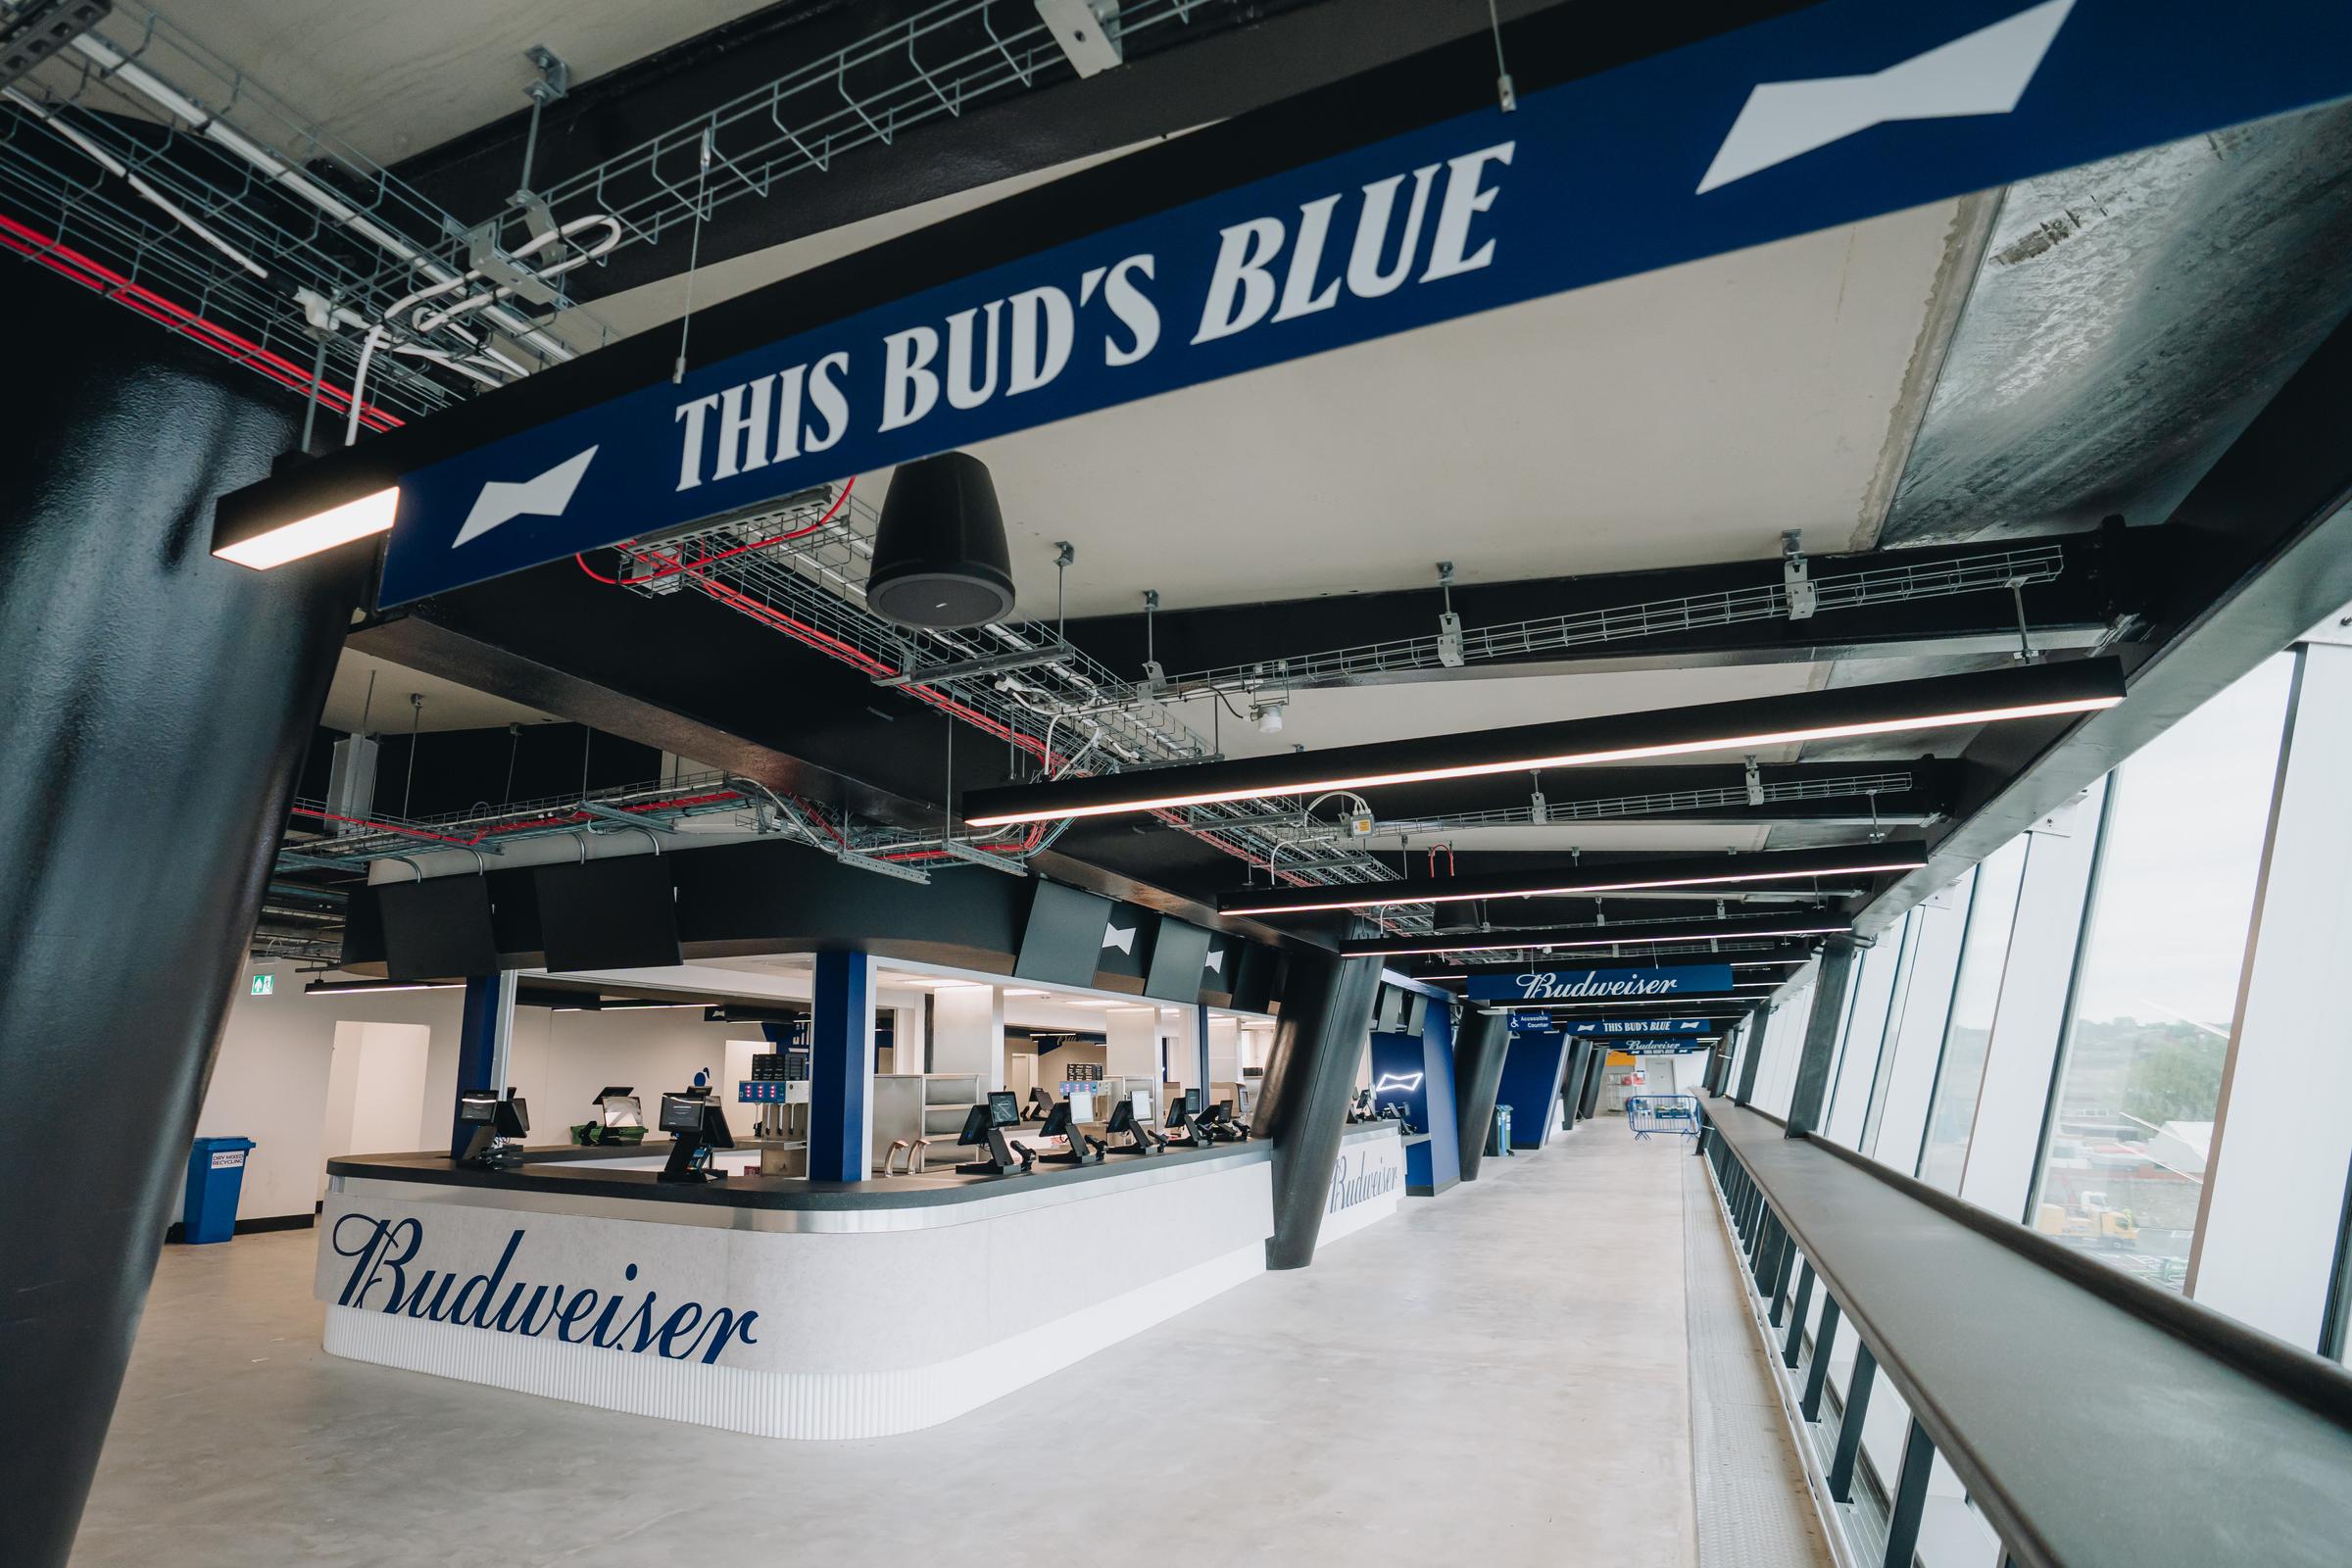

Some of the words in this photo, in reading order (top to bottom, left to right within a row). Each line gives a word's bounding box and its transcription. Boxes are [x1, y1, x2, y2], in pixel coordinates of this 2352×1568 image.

[675, 352, 850, 492] THIS
[878, 254, 1160, 432] BUD'S
[1190, 140, 1516, 346] BLUE
[1515, 970, 1678, 1000] Budweiser
[1602, 1022, 1623, 1032] THIS
[1624, 1022, 1648, 1032] BUD'S
[1649, 1020, 1672, 1031] BLUE
[1626, 1040, 1680, 1050] Budweiser
[1329, 1150, 1397, 1214] Budweiser
[332, 1213, 759, 1365] Budweiser
